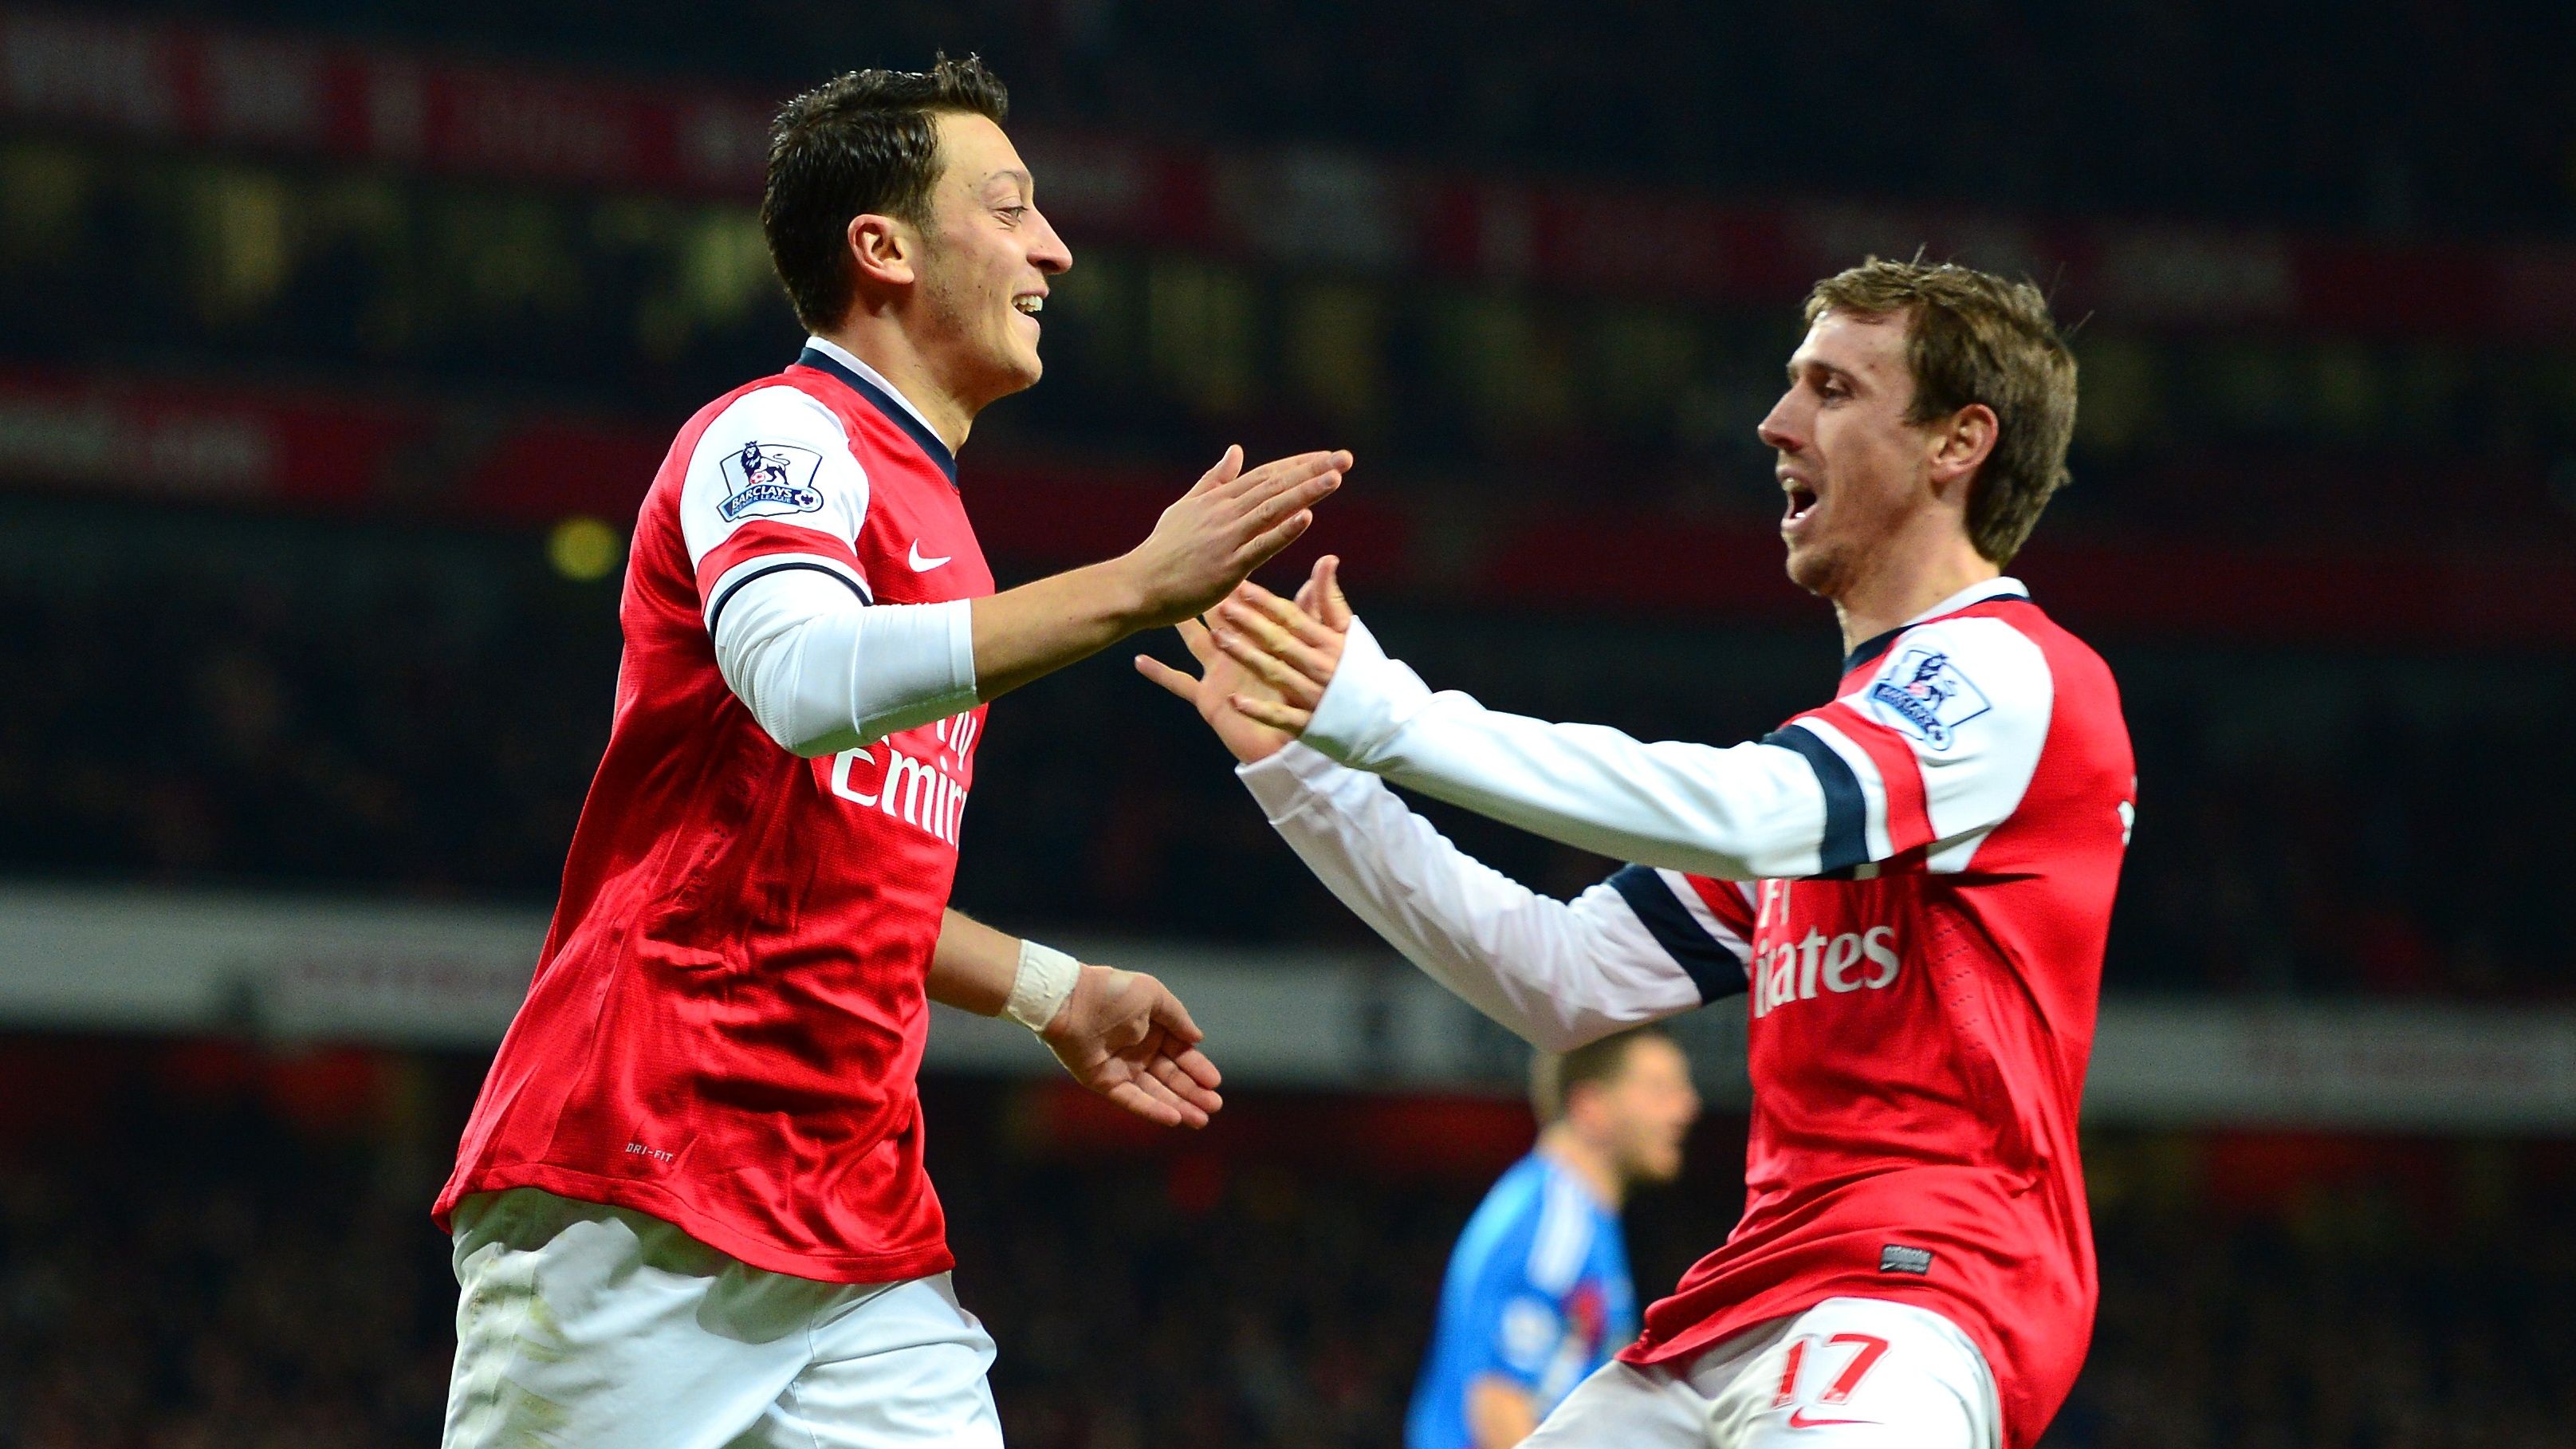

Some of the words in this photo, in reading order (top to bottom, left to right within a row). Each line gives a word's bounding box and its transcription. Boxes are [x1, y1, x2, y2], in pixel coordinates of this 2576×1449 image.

[732, 485, 792, 509] BARCLAYS
[625, 1143, 673, 1162] DRI-FIT
[1771, 1333, 1892, 1409] 17
